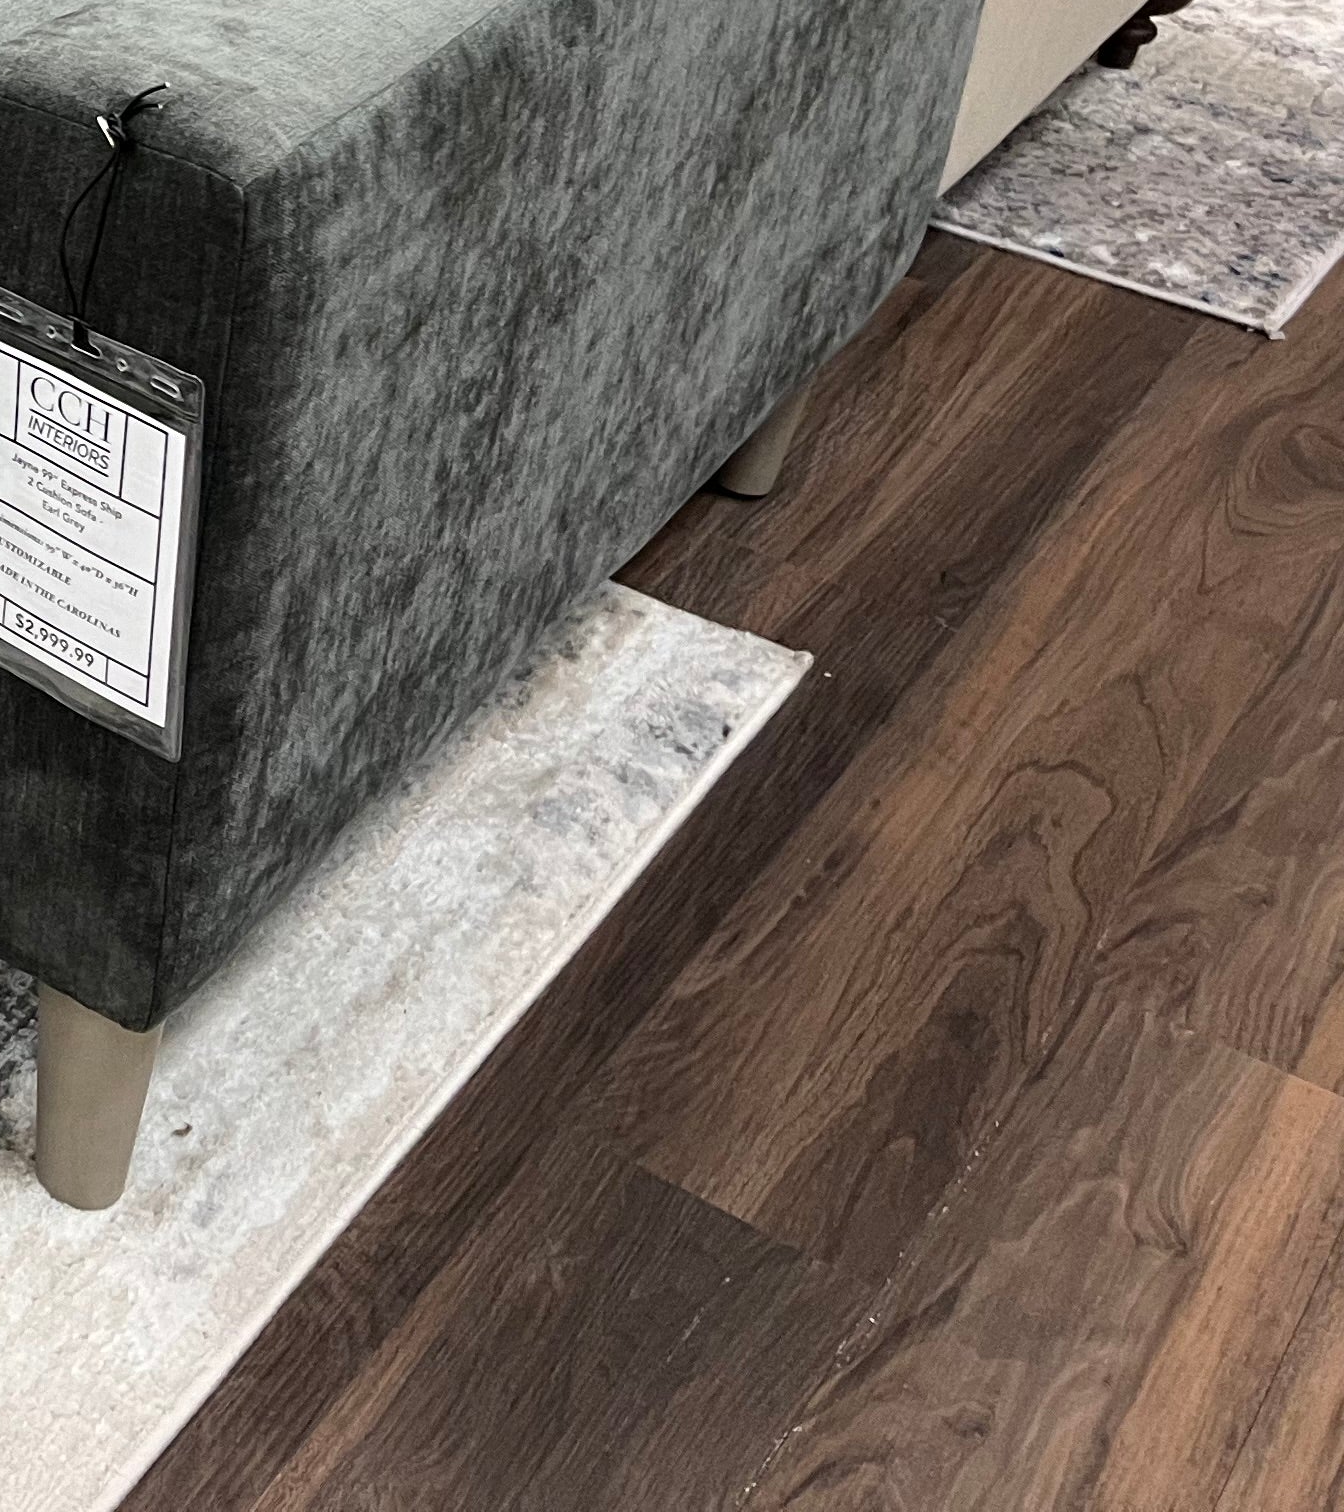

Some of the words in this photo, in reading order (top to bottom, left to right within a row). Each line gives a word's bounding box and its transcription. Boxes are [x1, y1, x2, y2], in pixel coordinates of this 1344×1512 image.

[30, 377, 113, 444] CCH
[28, 415, 109, 470] INTERIORS
[27, 476, 34, 487] 2
[36, 481, 73, 508] Cushion
[75, 503, 97, 522] Sofa
[42, 500, 60, 517] Earl
[62, 513, 86, 533] Grey
[60, 479, 98, 506] Express
[100, 501, 123, 520] Ship
[20, 576, 32, 589] IN
[33, 583, 56, 604] THE
[56, 598, 121, 639] CAROLINAS
[15, 613, 95, 668] $2,999.99
